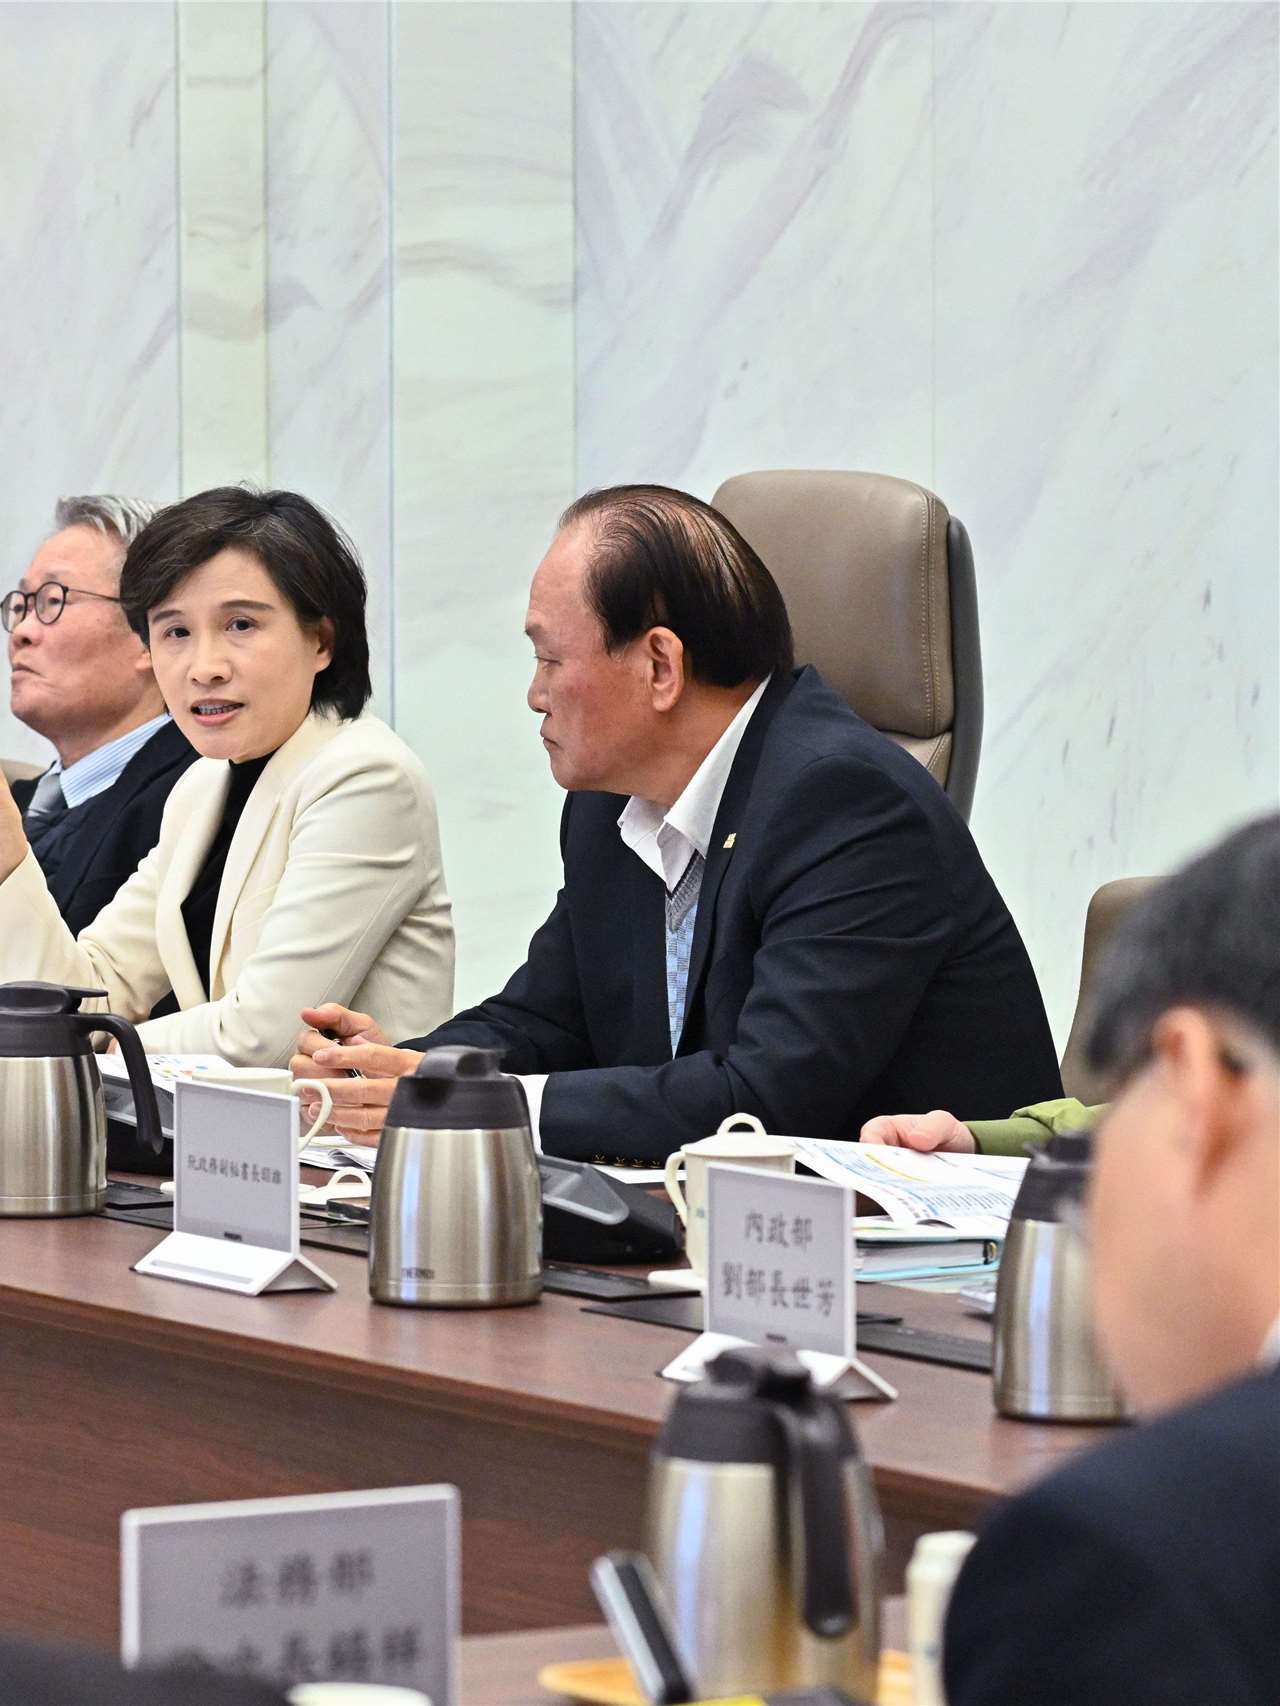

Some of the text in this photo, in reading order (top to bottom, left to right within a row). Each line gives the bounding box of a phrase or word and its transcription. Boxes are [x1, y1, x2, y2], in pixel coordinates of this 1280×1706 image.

[722, 1261, 836, 1318] 劉部長世芳
